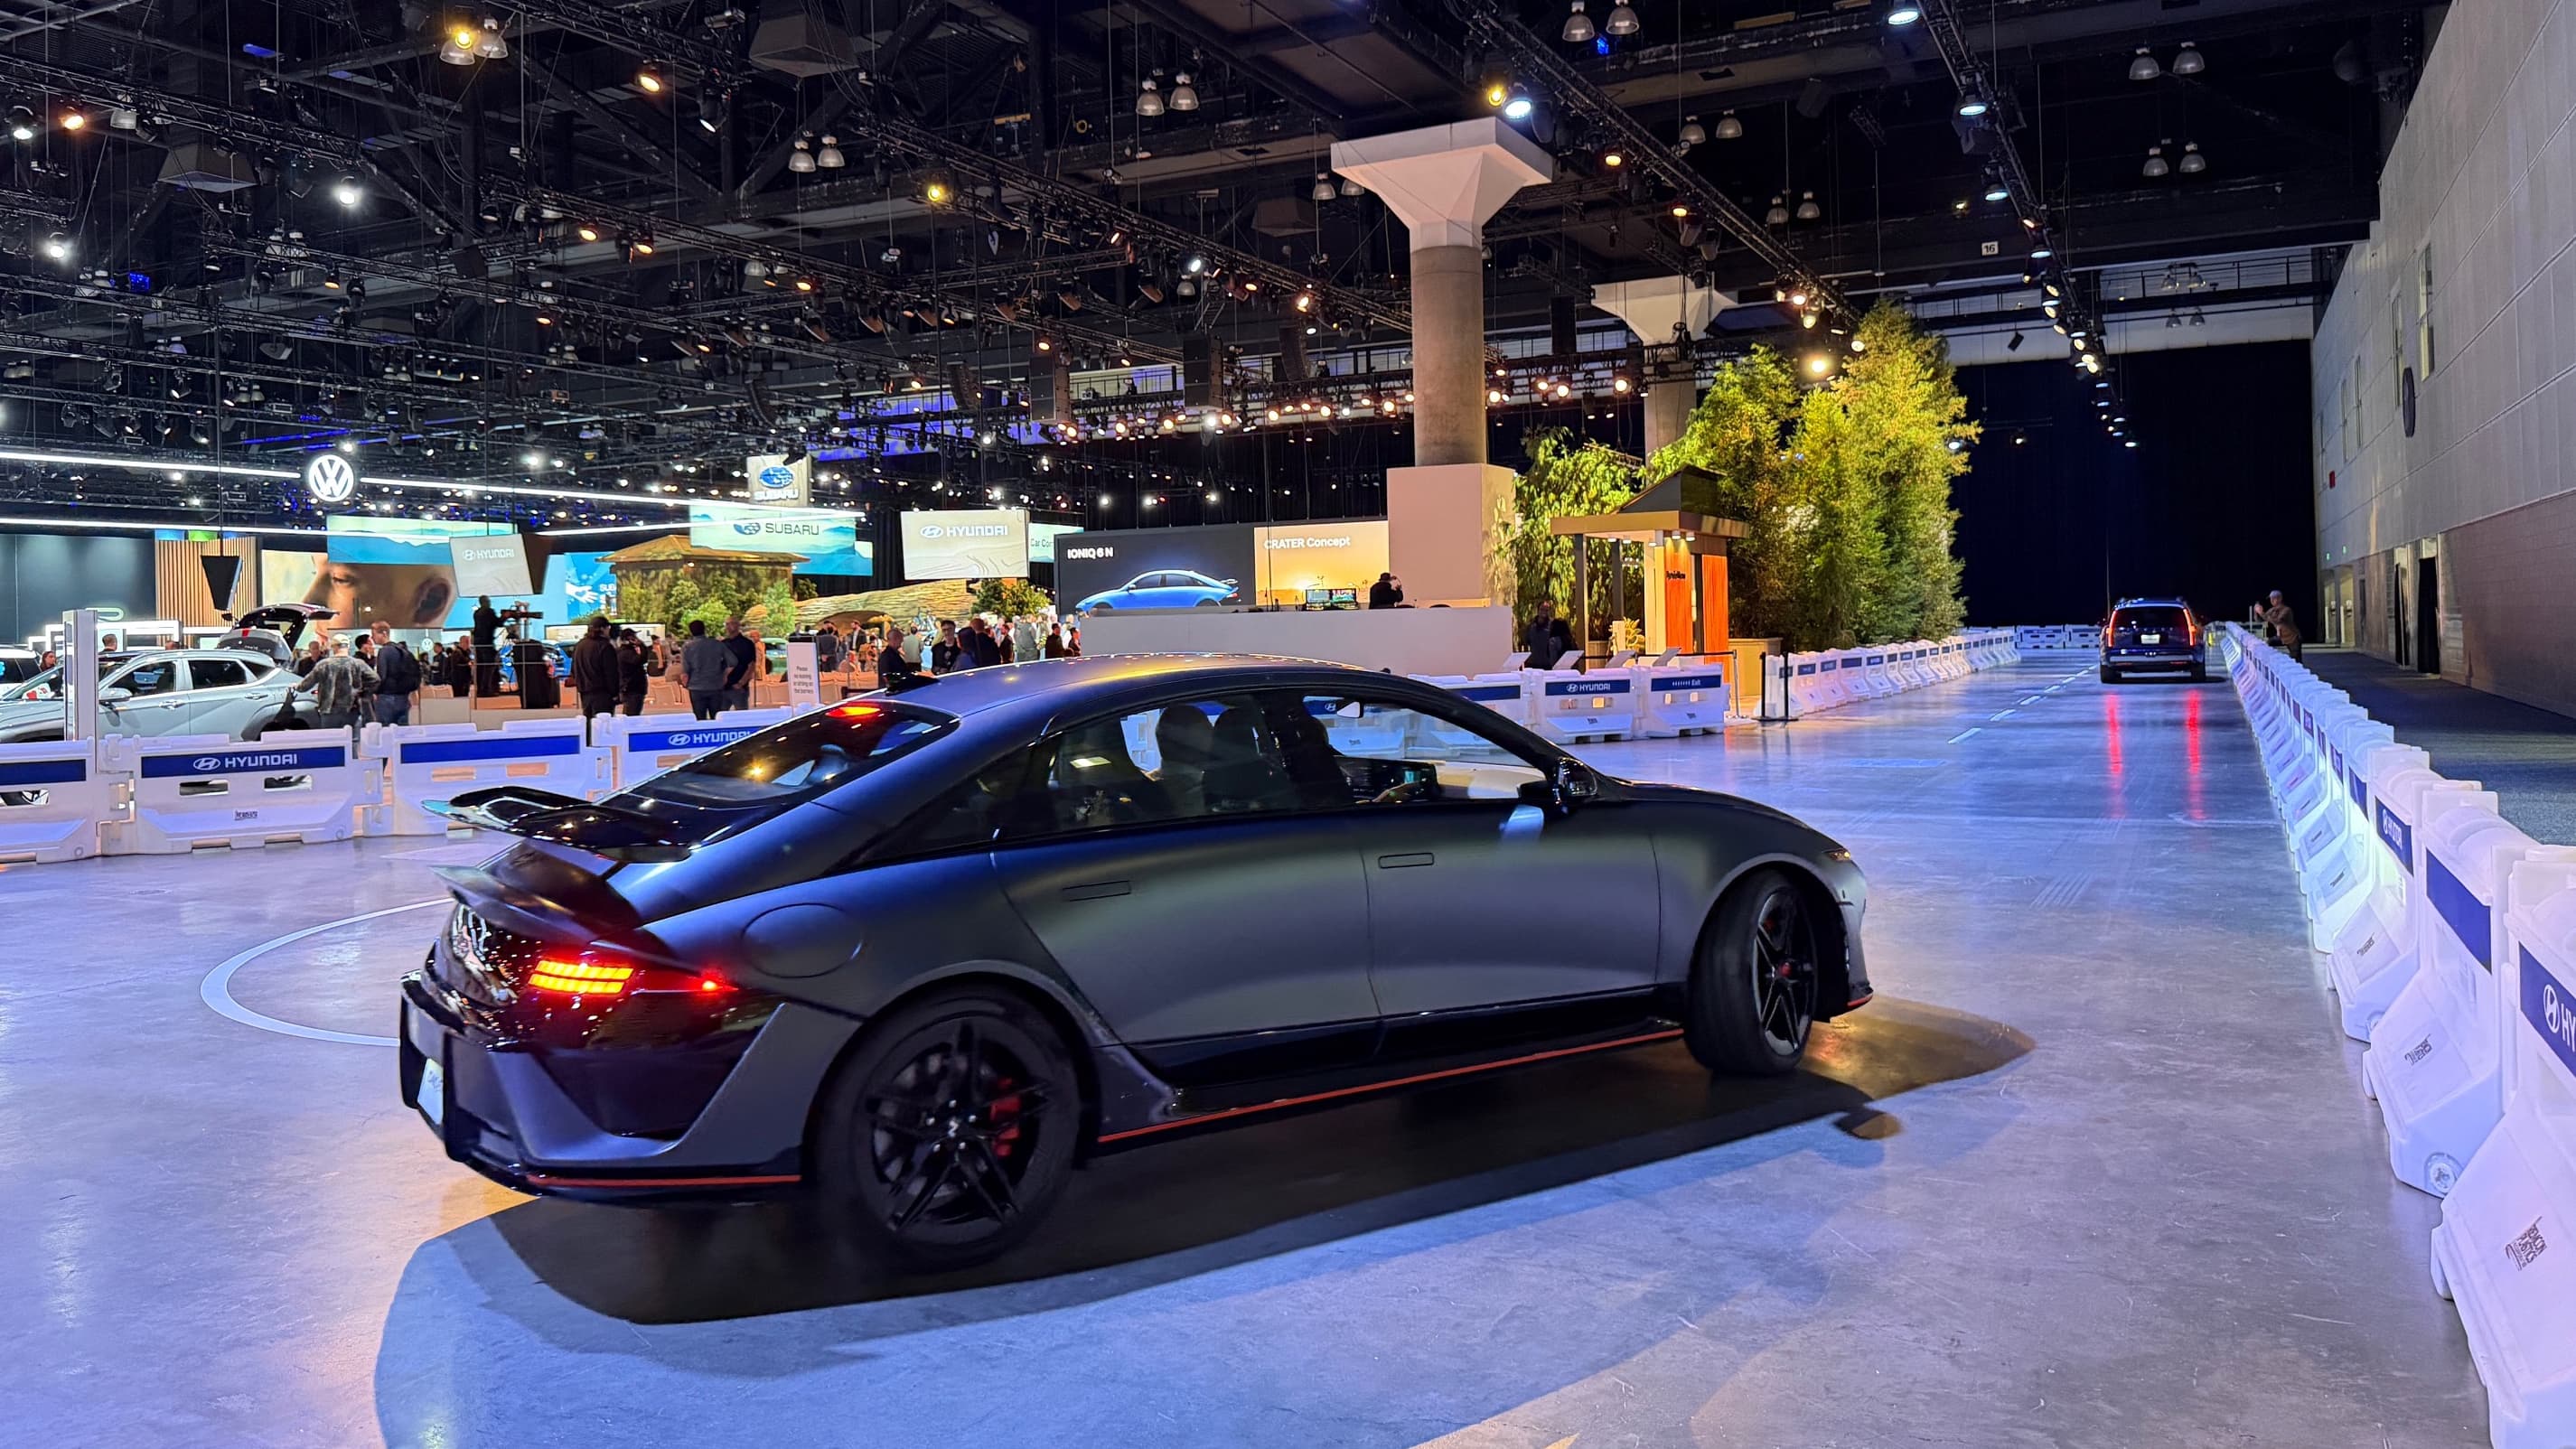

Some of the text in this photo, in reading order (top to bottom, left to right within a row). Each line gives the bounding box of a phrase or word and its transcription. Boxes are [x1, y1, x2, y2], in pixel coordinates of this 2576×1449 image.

[1983, 244, 1995, 253] 16
[754, 489, 799, 500] SUBARU
[765, 522, 820, 536] SUBARU
[947, 525, 1007, 537] HYUNDAI
[1264, 535, 1351, 549] CRATER Concept
[477, 548, 515, 560] HYUNDAI
[1068, 547, 1114, 559] IONIQ 6 N
[1579, 683, 1611, 692] HYUNDAI
[225, 753, 297, 768] HYUNDAI
